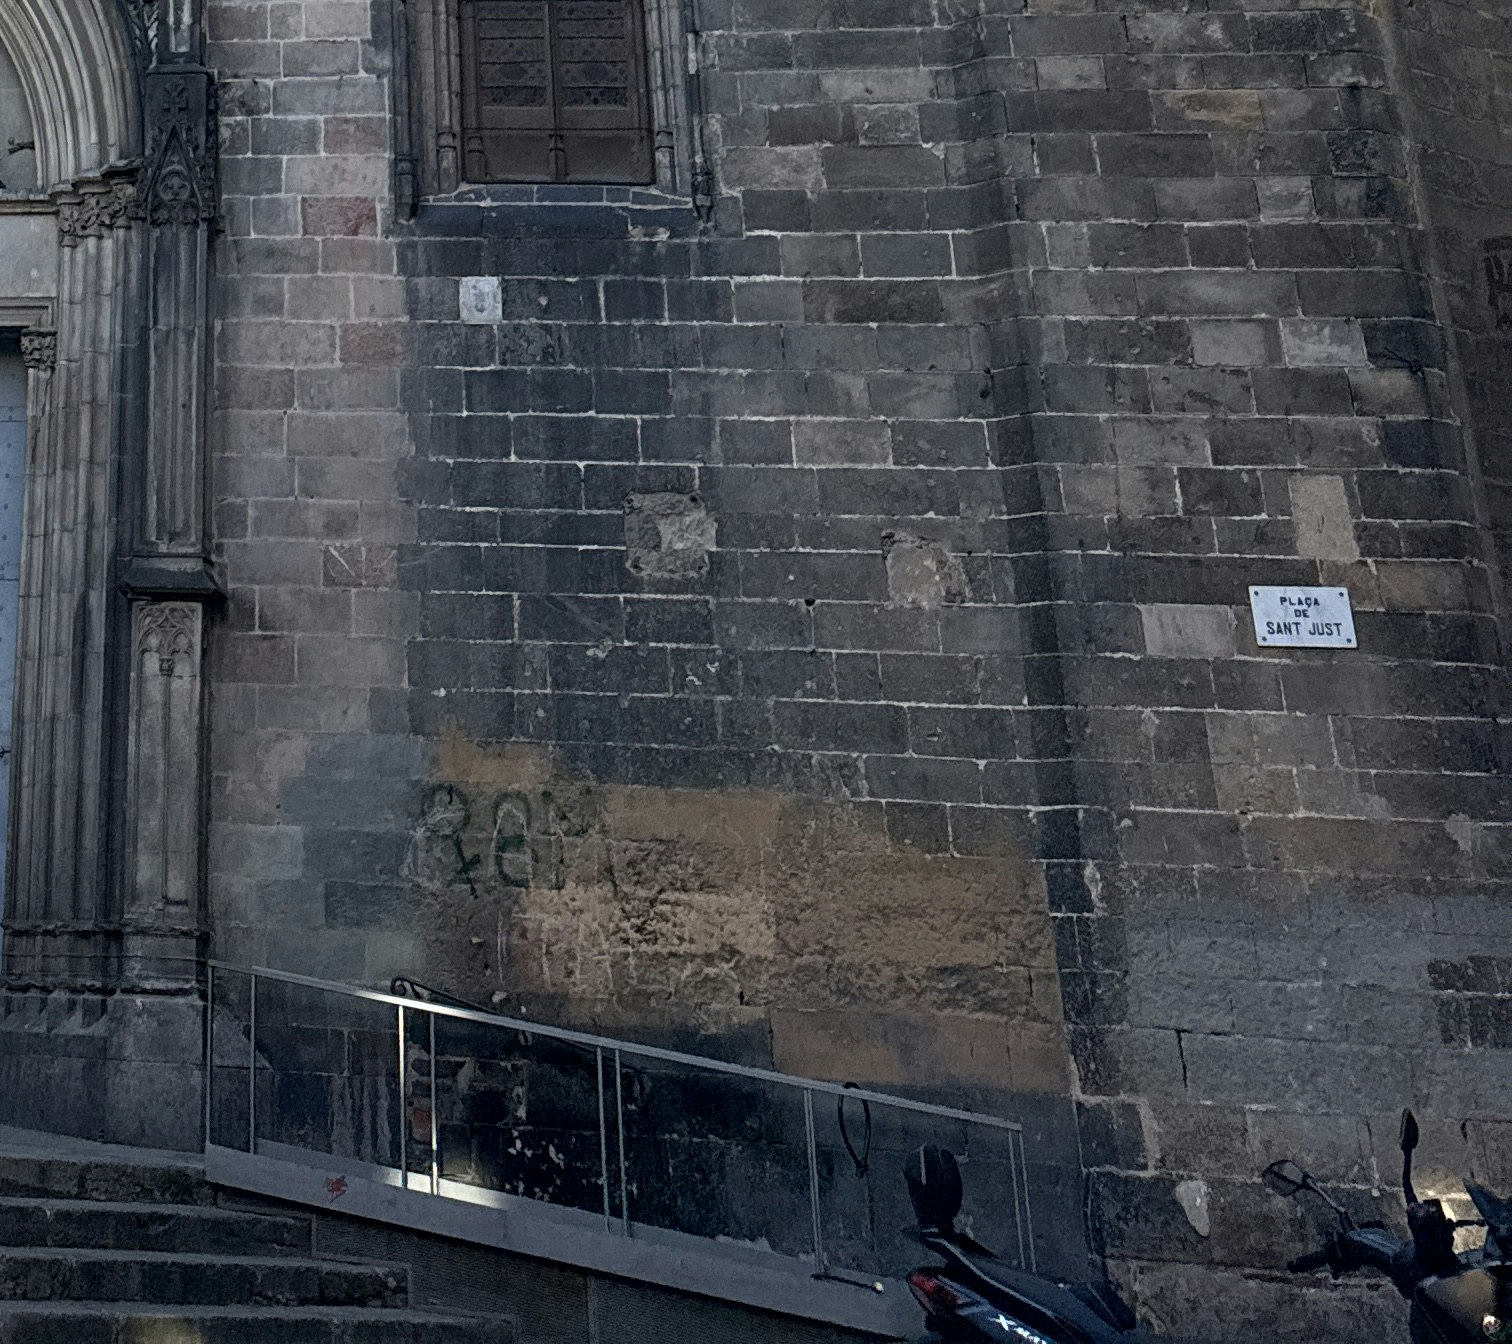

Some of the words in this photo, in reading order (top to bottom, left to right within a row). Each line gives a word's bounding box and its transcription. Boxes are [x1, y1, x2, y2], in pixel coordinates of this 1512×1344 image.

[1279, 596, 1320, 608] PLAÇA
[1293, 608, 1310, 618] DE
[1266, 621, 1302, 635] SANT
[1308, 622, 1343, 636] JUST
